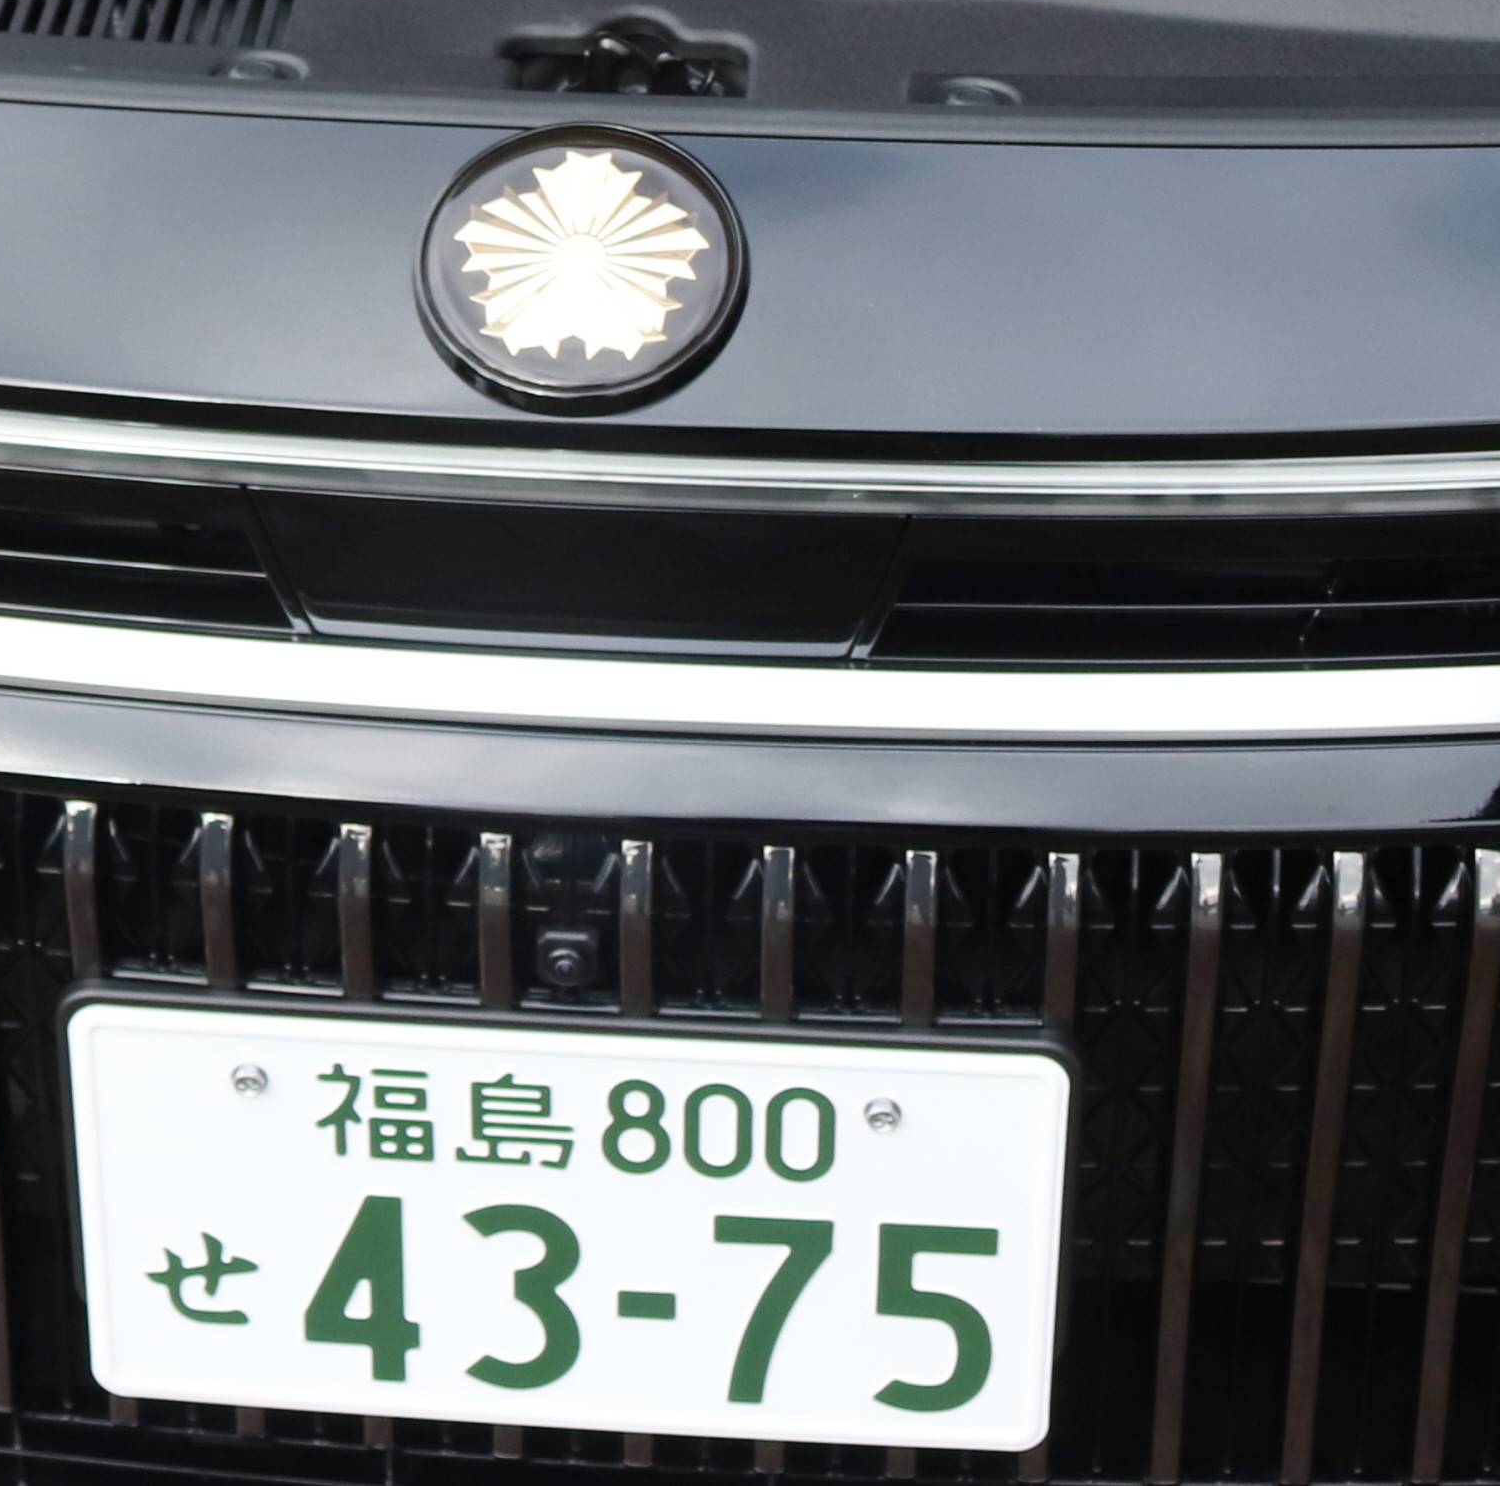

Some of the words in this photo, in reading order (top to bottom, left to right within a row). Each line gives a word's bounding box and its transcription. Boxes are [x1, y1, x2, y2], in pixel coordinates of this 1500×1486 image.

[316, 1063, 575, 1170] 福島
[601, 1078, 836, 1183] 800
[145, 1232, 260, 1326] せ
[304, 1195, 1000, 1413] 43-75
